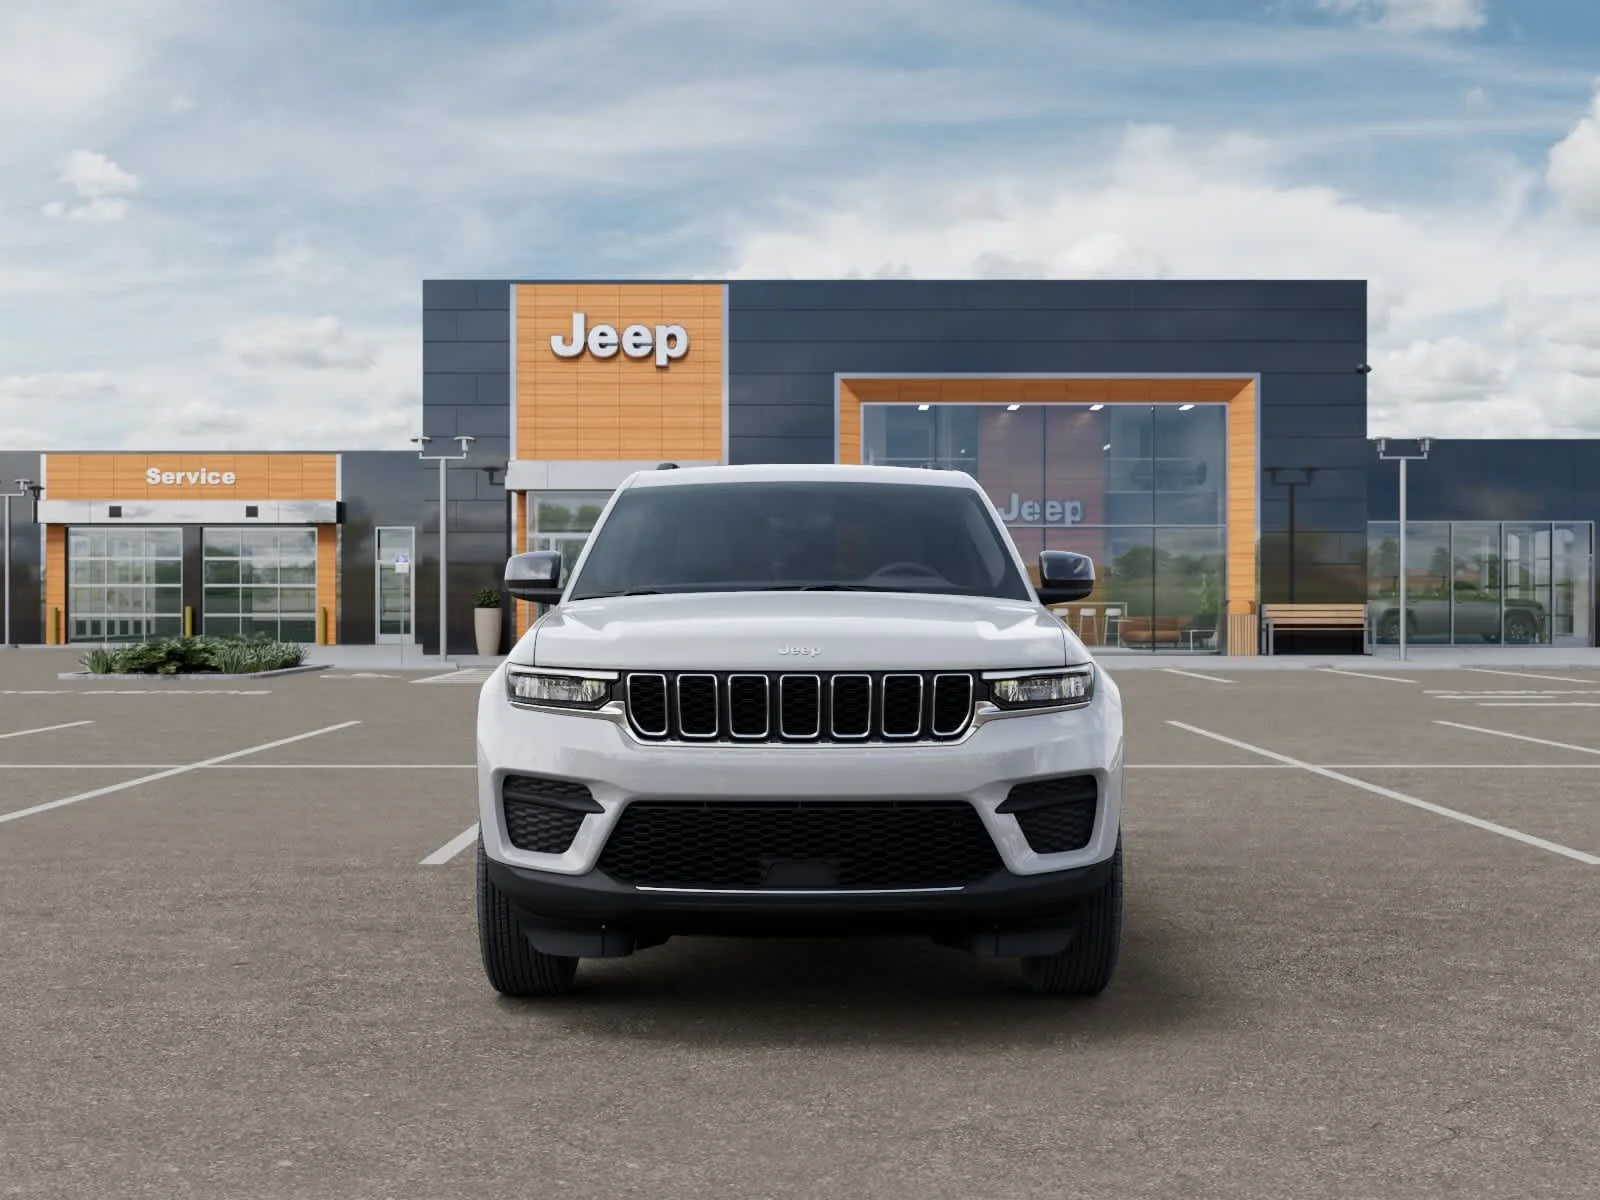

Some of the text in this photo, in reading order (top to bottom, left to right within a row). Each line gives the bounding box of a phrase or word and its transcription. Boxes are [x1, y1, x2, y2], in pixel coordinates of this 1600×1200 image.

[550, 311, 689, 368] Jeep
[146, 466, 236, 485] Service
[997, 492, 1084, 526] Jeep
[777, 642, 822, 658] Jeep
